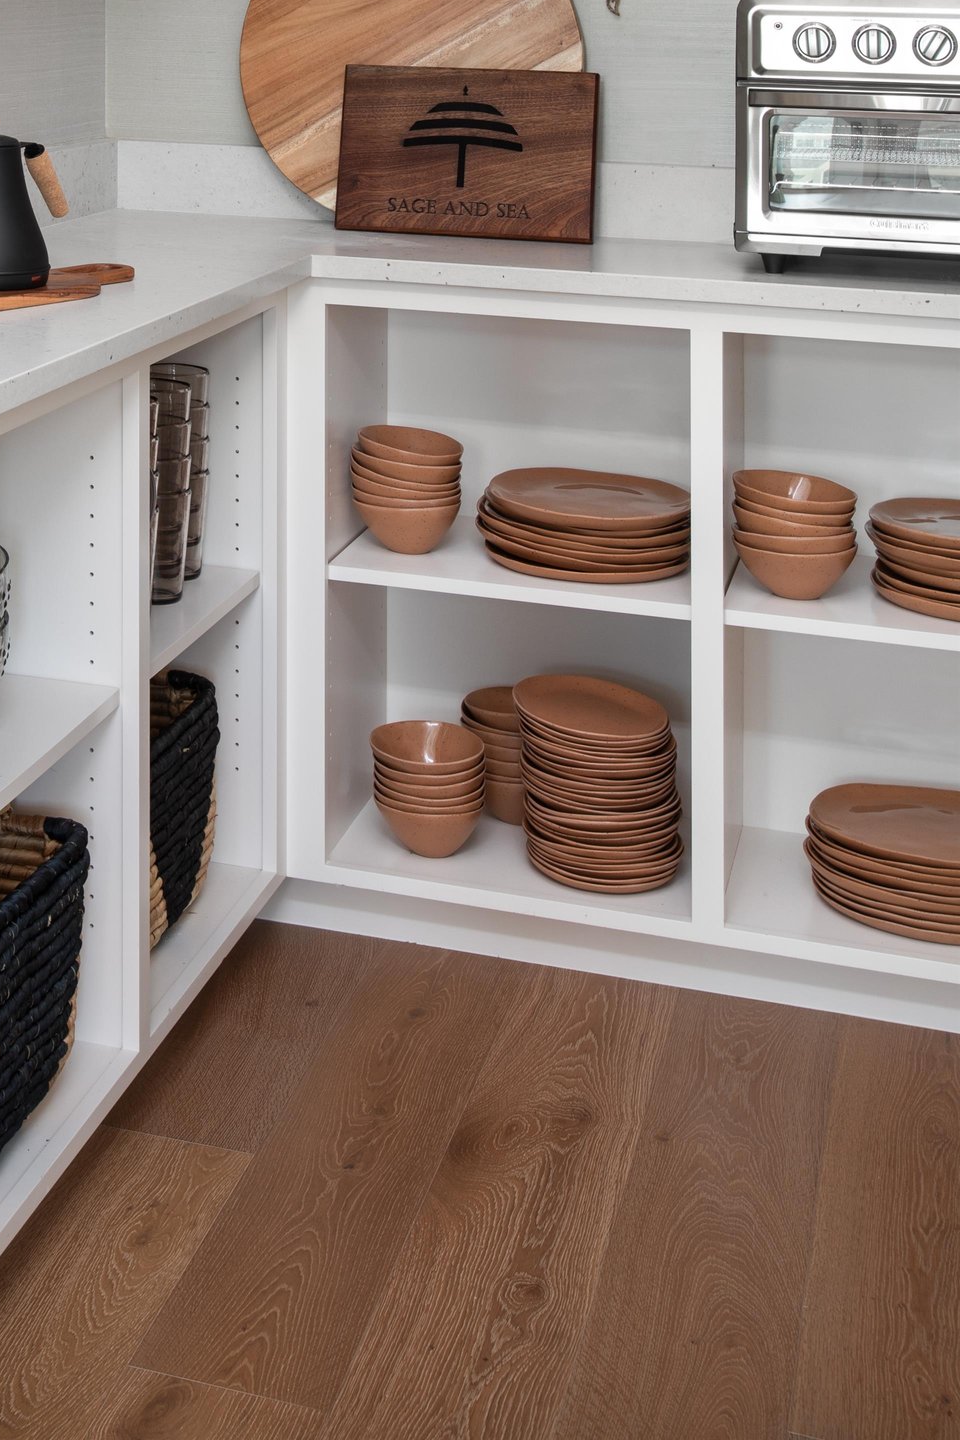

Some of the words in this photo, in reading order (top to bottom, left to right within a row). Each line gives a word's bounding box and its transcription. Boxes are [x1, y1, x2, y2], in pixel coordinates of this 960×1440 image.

[387, 197, 437, 215] SAGE
[442, 200, 490, 217] AND
[496, 203, 532, 220] SEA
